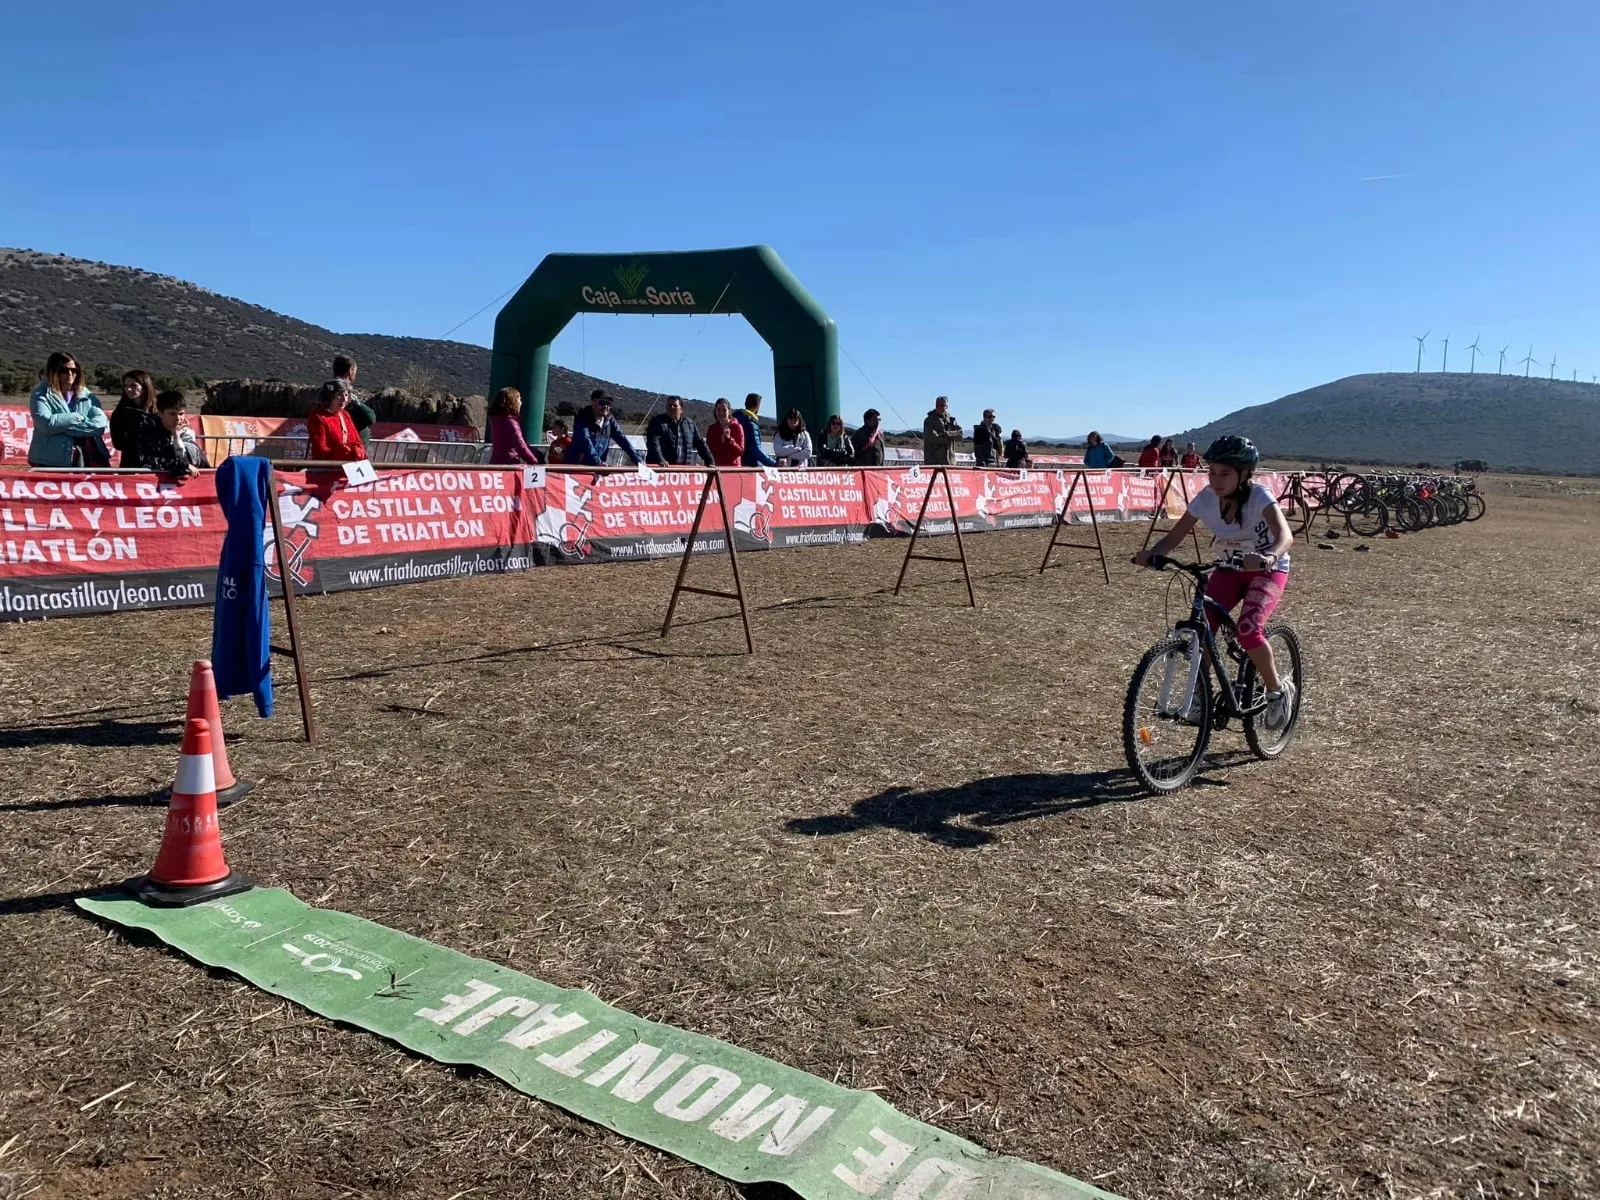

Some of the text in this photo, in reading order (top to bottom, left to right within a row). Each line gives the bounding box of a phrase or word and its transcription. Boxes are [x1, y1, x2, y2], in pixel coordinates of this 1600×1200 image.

[582, 285, 621, 307] Caja
[645, 286, 696, 305] Soria
[356, 467, 365, 478] 1
[479, 472, 504, 490] DE
[531, 472, 538, 482] 2
[136, 482, 183, 499] DE
[599, 491, 671, 508] CASTILLA
[673, 490, 682, 505] Y
[779, 488, 827, 502] CASTILLA
[829, 489, 836, 501] Y
[903, 487, 942, 499] CASTLLA
[332, 490, 522, 519] CASTILLA Y LEÓN
[781, 505, 797, 518] DE
[80, 507, 103, 530] Y
[116, 499, 203, 529] LEÓN
[602, 512, 627, 528] DE
[337, 515, 485, 545] DE TRIATLÓN
[349, 553, 530, 585] www.triatloncastillayleon.com
[414, 978, 836, 1156] MONTAJE
